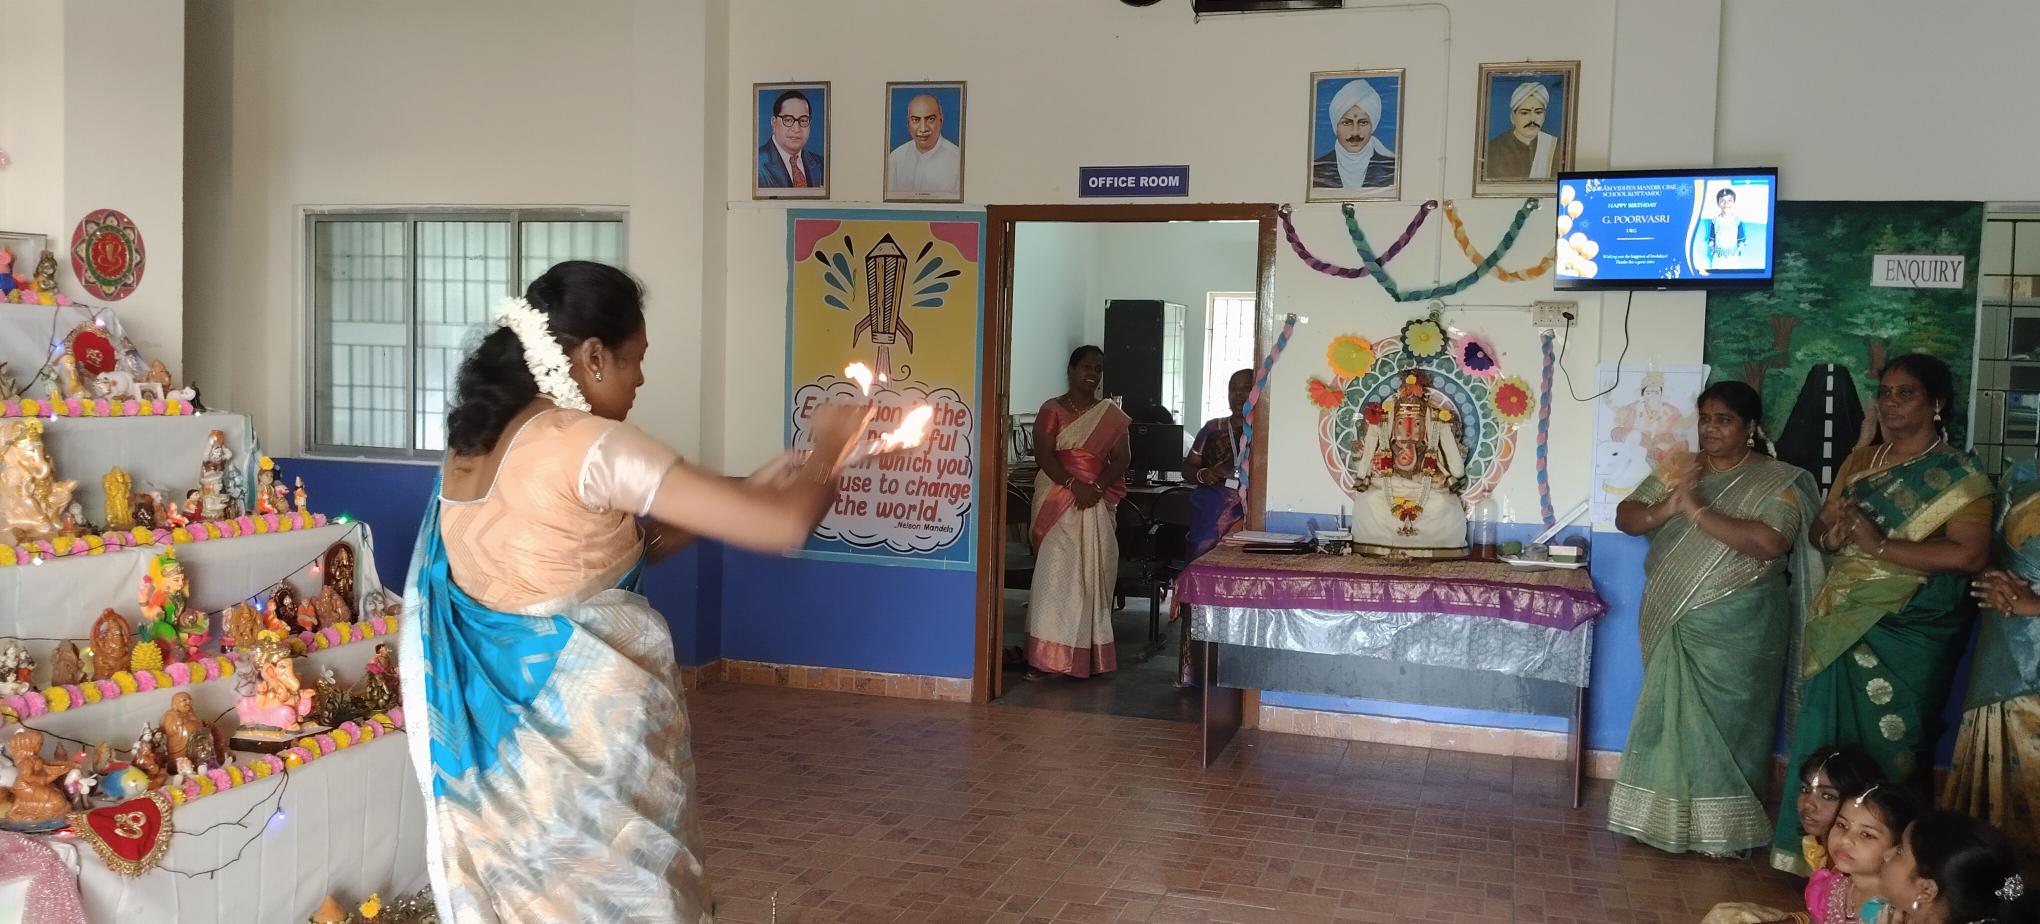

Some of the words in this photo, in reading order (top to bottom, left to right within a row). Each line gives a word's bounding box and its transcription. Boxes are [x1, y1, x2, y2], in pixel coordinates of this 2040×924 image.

[1088, 176, 1136, 188] OFFICE
[1139, 175, 1180, 187] ROOM
[1614, 214, 1671, 224] POORVASRI
[1885, 259, 1962, 288] ENQUIRY
[933, 402, 967, 428] the
[937, 458, 969, 479] you
[838, 475, 872, 493] use
[879, 473, 899, 494] to
[904, 476, 971, 505] change
[834, 494, 868, 516] the
[876, 500, 942, 522] world.
[924, 523, 954, 533] Mandela
